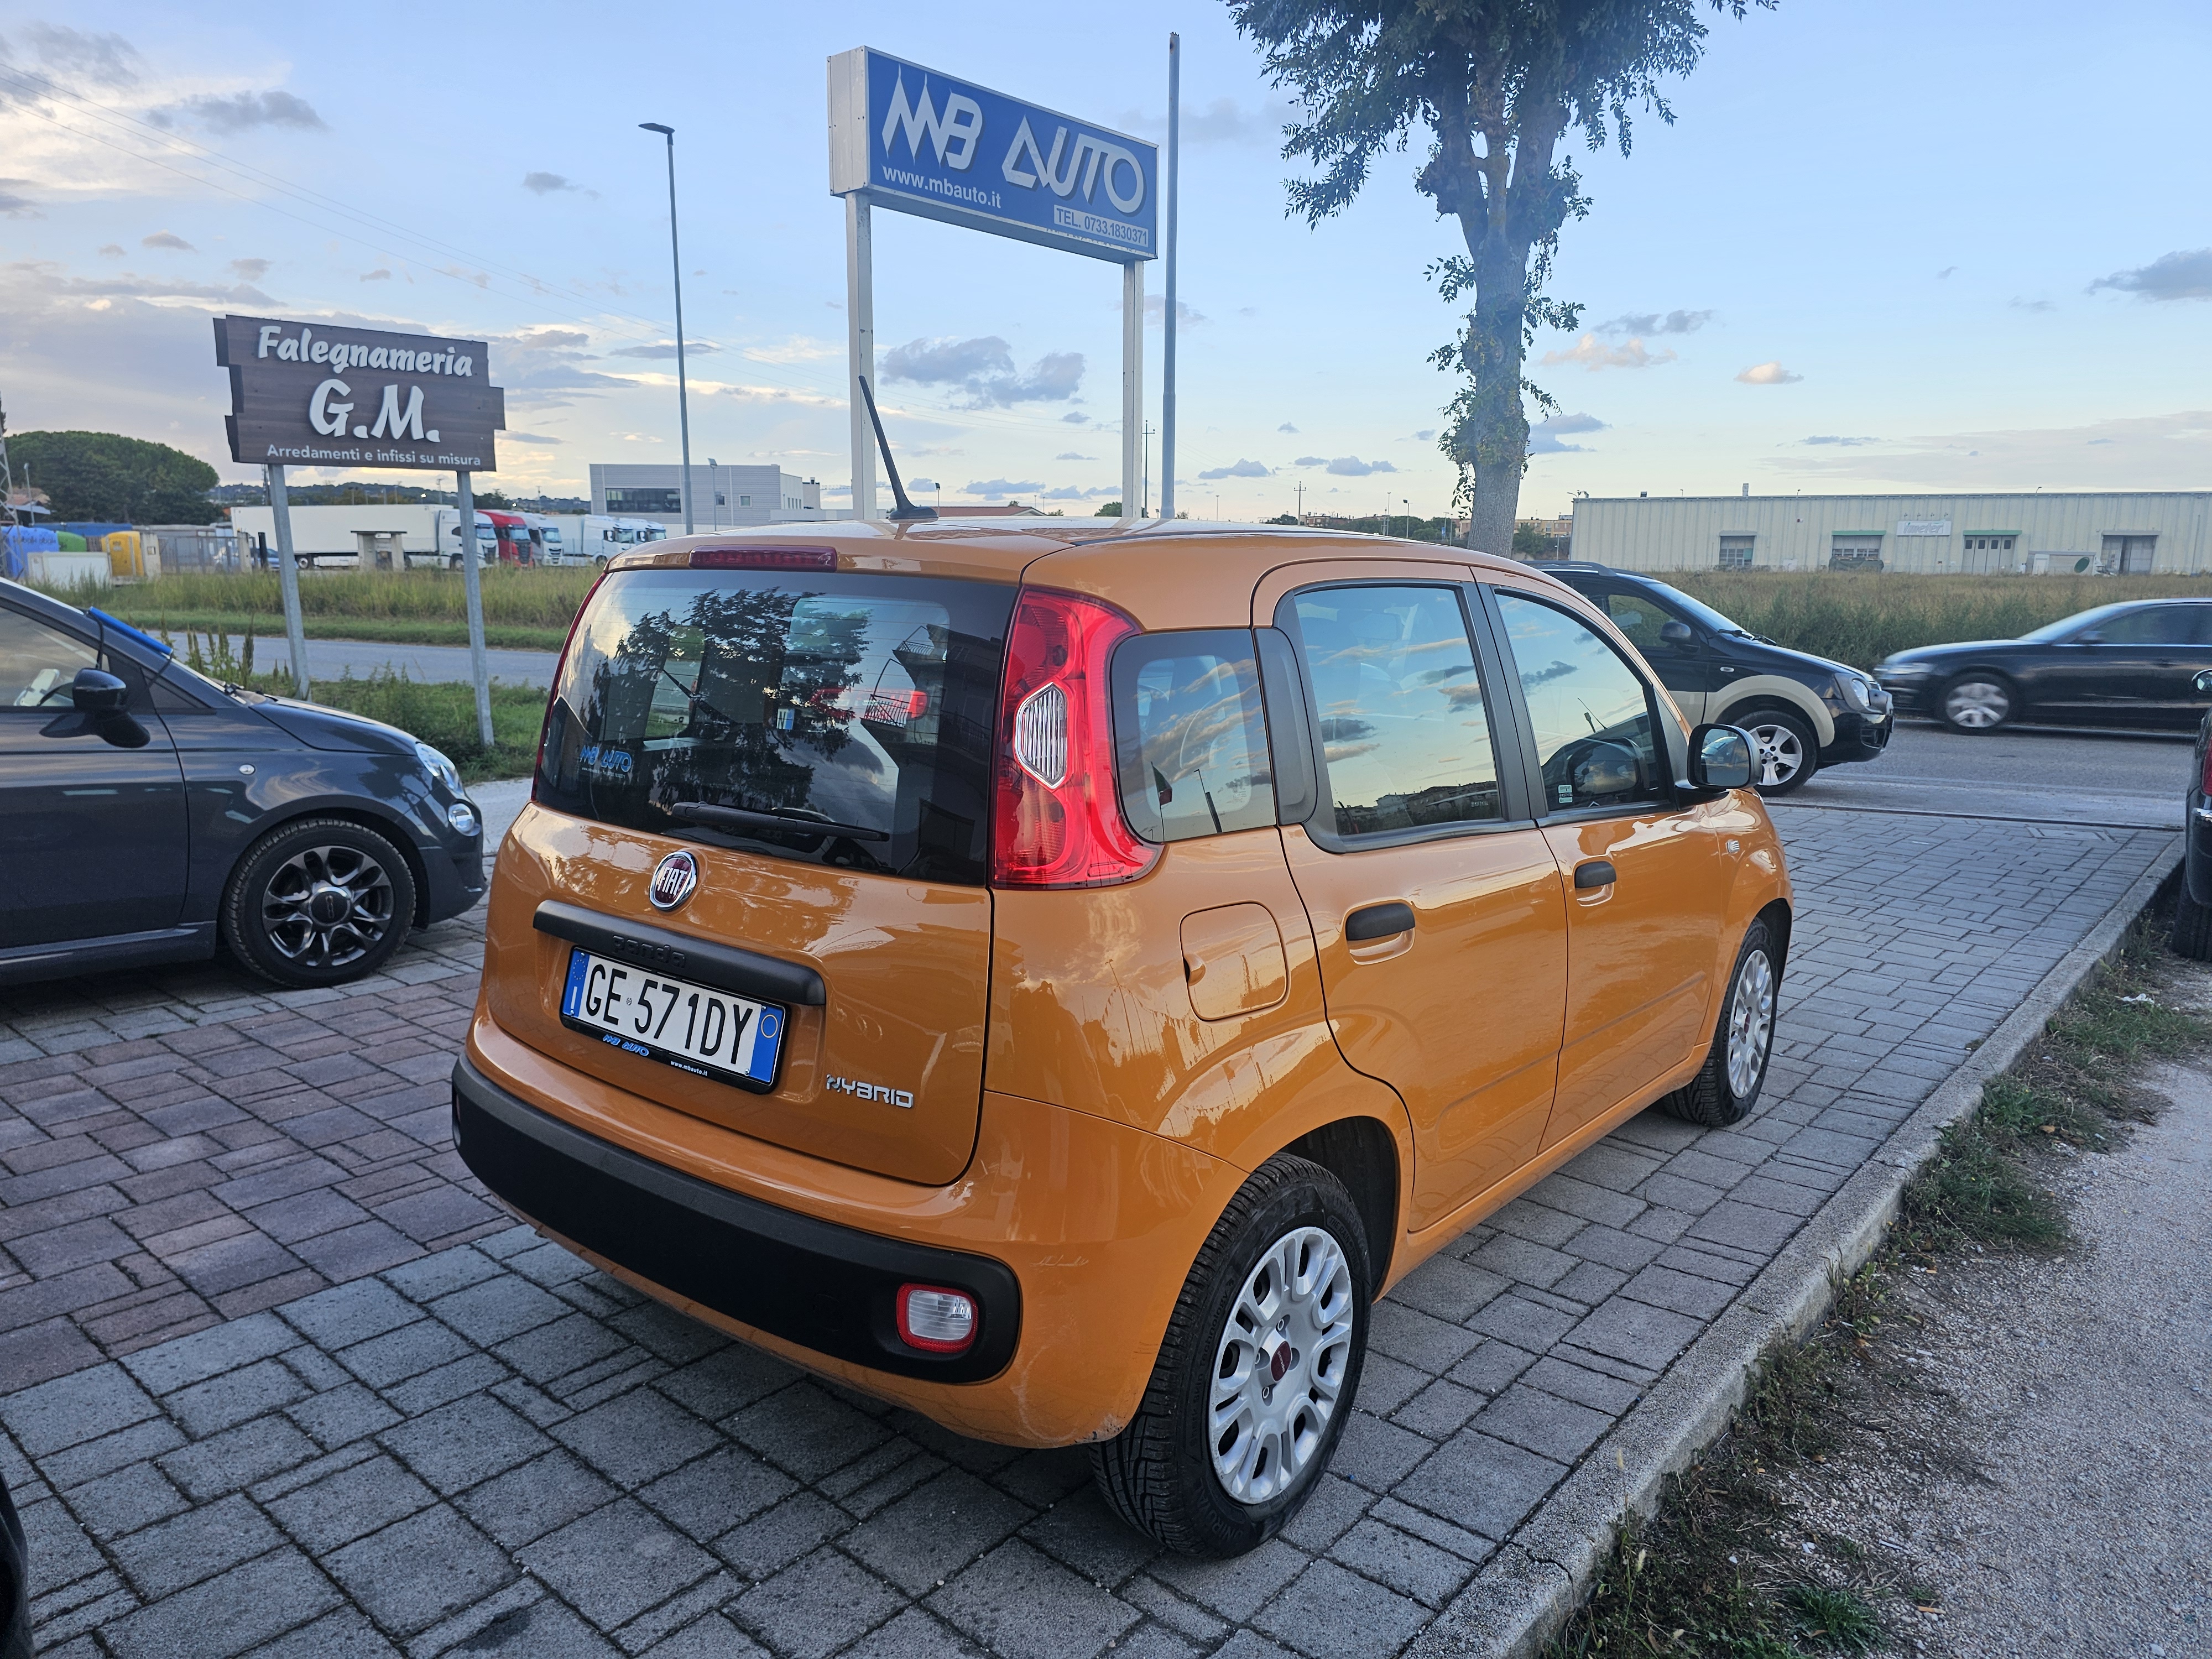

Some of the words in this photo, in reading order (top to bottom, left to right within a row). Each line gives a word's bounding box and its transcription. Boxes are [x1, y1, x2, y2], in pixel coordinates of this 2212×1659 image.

[881, 64, 983, 170] MB
[1001, 114, 1144, 213] AUTO
[883, 165, 1001, 208] www.mbauto.it
[1056, 207, 1081, 228] TEL.
[1084, 216, 1147, 245] 0733.1830371
[258, 325, 473, 377] Falegnameria
[309, 379, 441, 442] G.M.
[267, 444, 360, 461] Arredamenti
[364, 451, 373, 461] e
[377, 449, 416, 463] infissi
[419, 455, 435, 464] su
[439, 453, 481, 466] misura
[580, 745, 599, 765] MB
[601, 749, 632, 773] AUTO
[656, 867, 688, 896] FIAT
[612, 935, 686, 968] panda
[602, 1034, 620, 1046] MB
[622, 1041, 649, 1056] AUTO
[670, 1060, 708, 1076] www.mbauto.it
[826, 1073, 914, 1108] HYBRID
[1329, 1217, 1340, 1229] THE
[1338, 1225, 1350, 1244] RAIN
[1199, 1290, 1228, 1366] Technology
